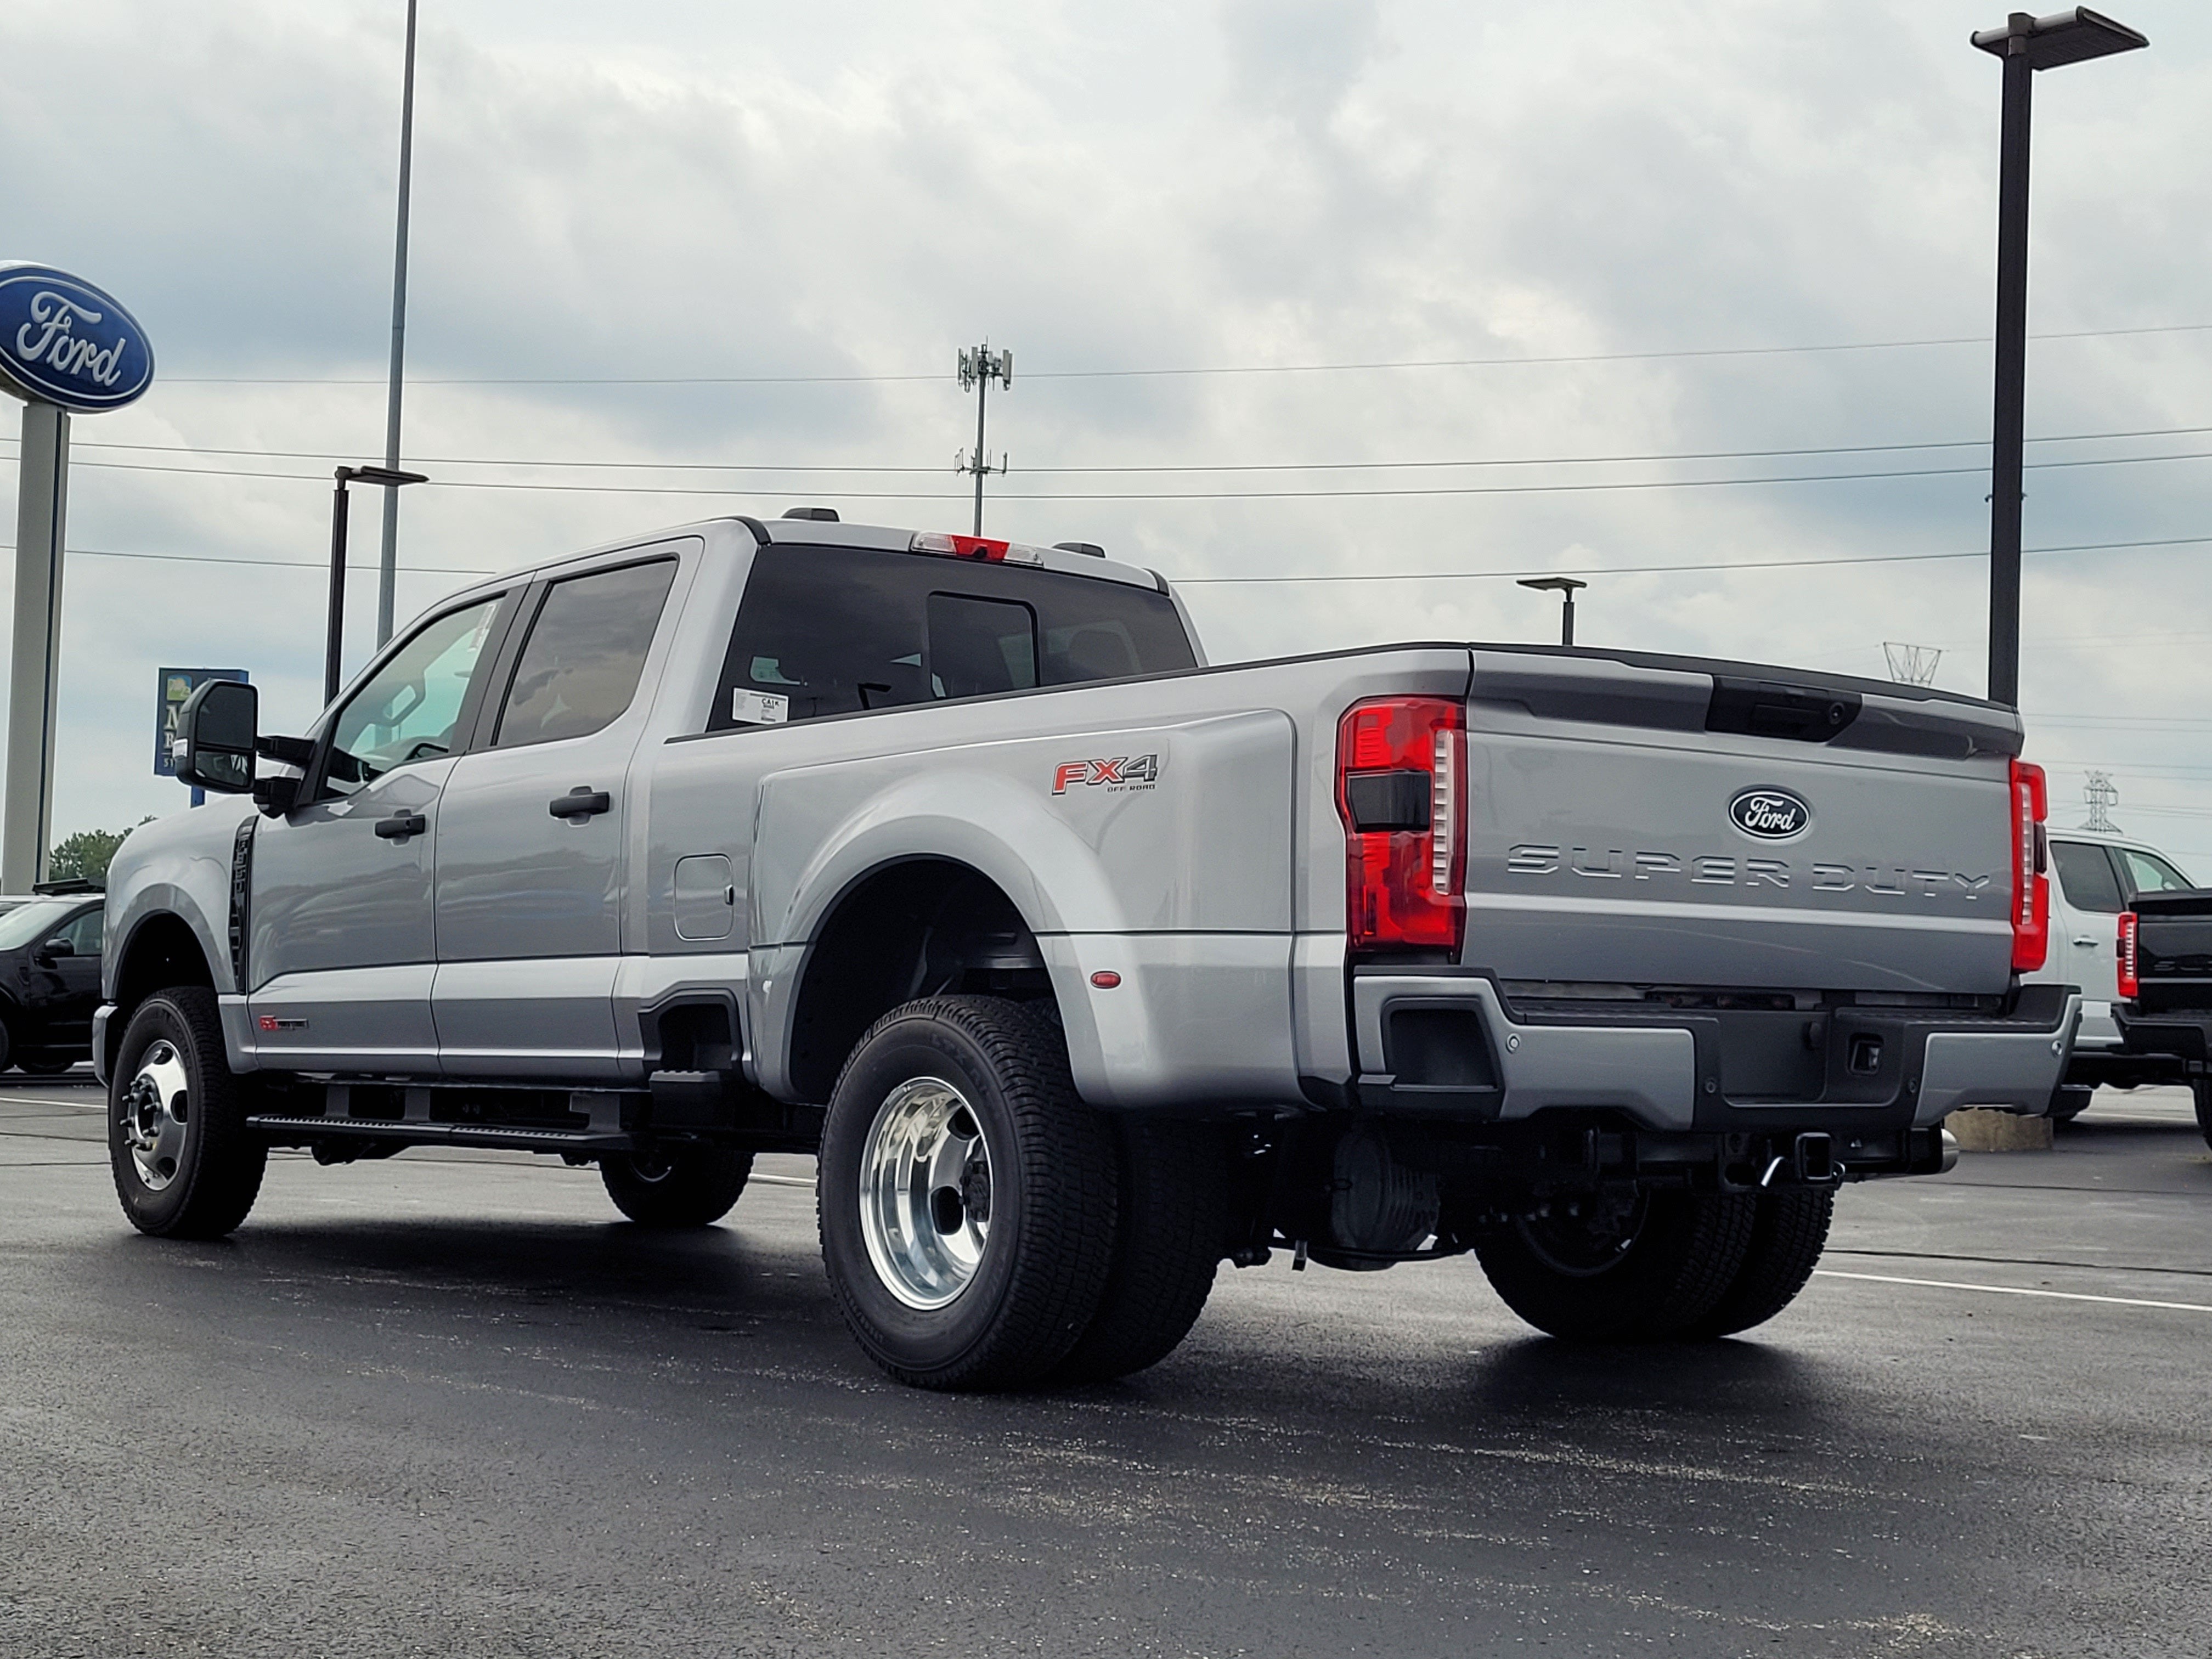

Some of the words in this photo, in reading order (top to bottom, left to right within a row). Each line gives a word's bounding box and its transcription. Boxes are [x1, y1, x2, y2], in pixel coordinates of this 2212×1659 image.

[16, 291, 126, 387] Ford
[1052, 754, 1158, 795] FX4
[1745, 796, 1797, 831] Ford
[1507, 844, 1790, 888] SUPER
[1813, 862, 1990, 900] DUTY
